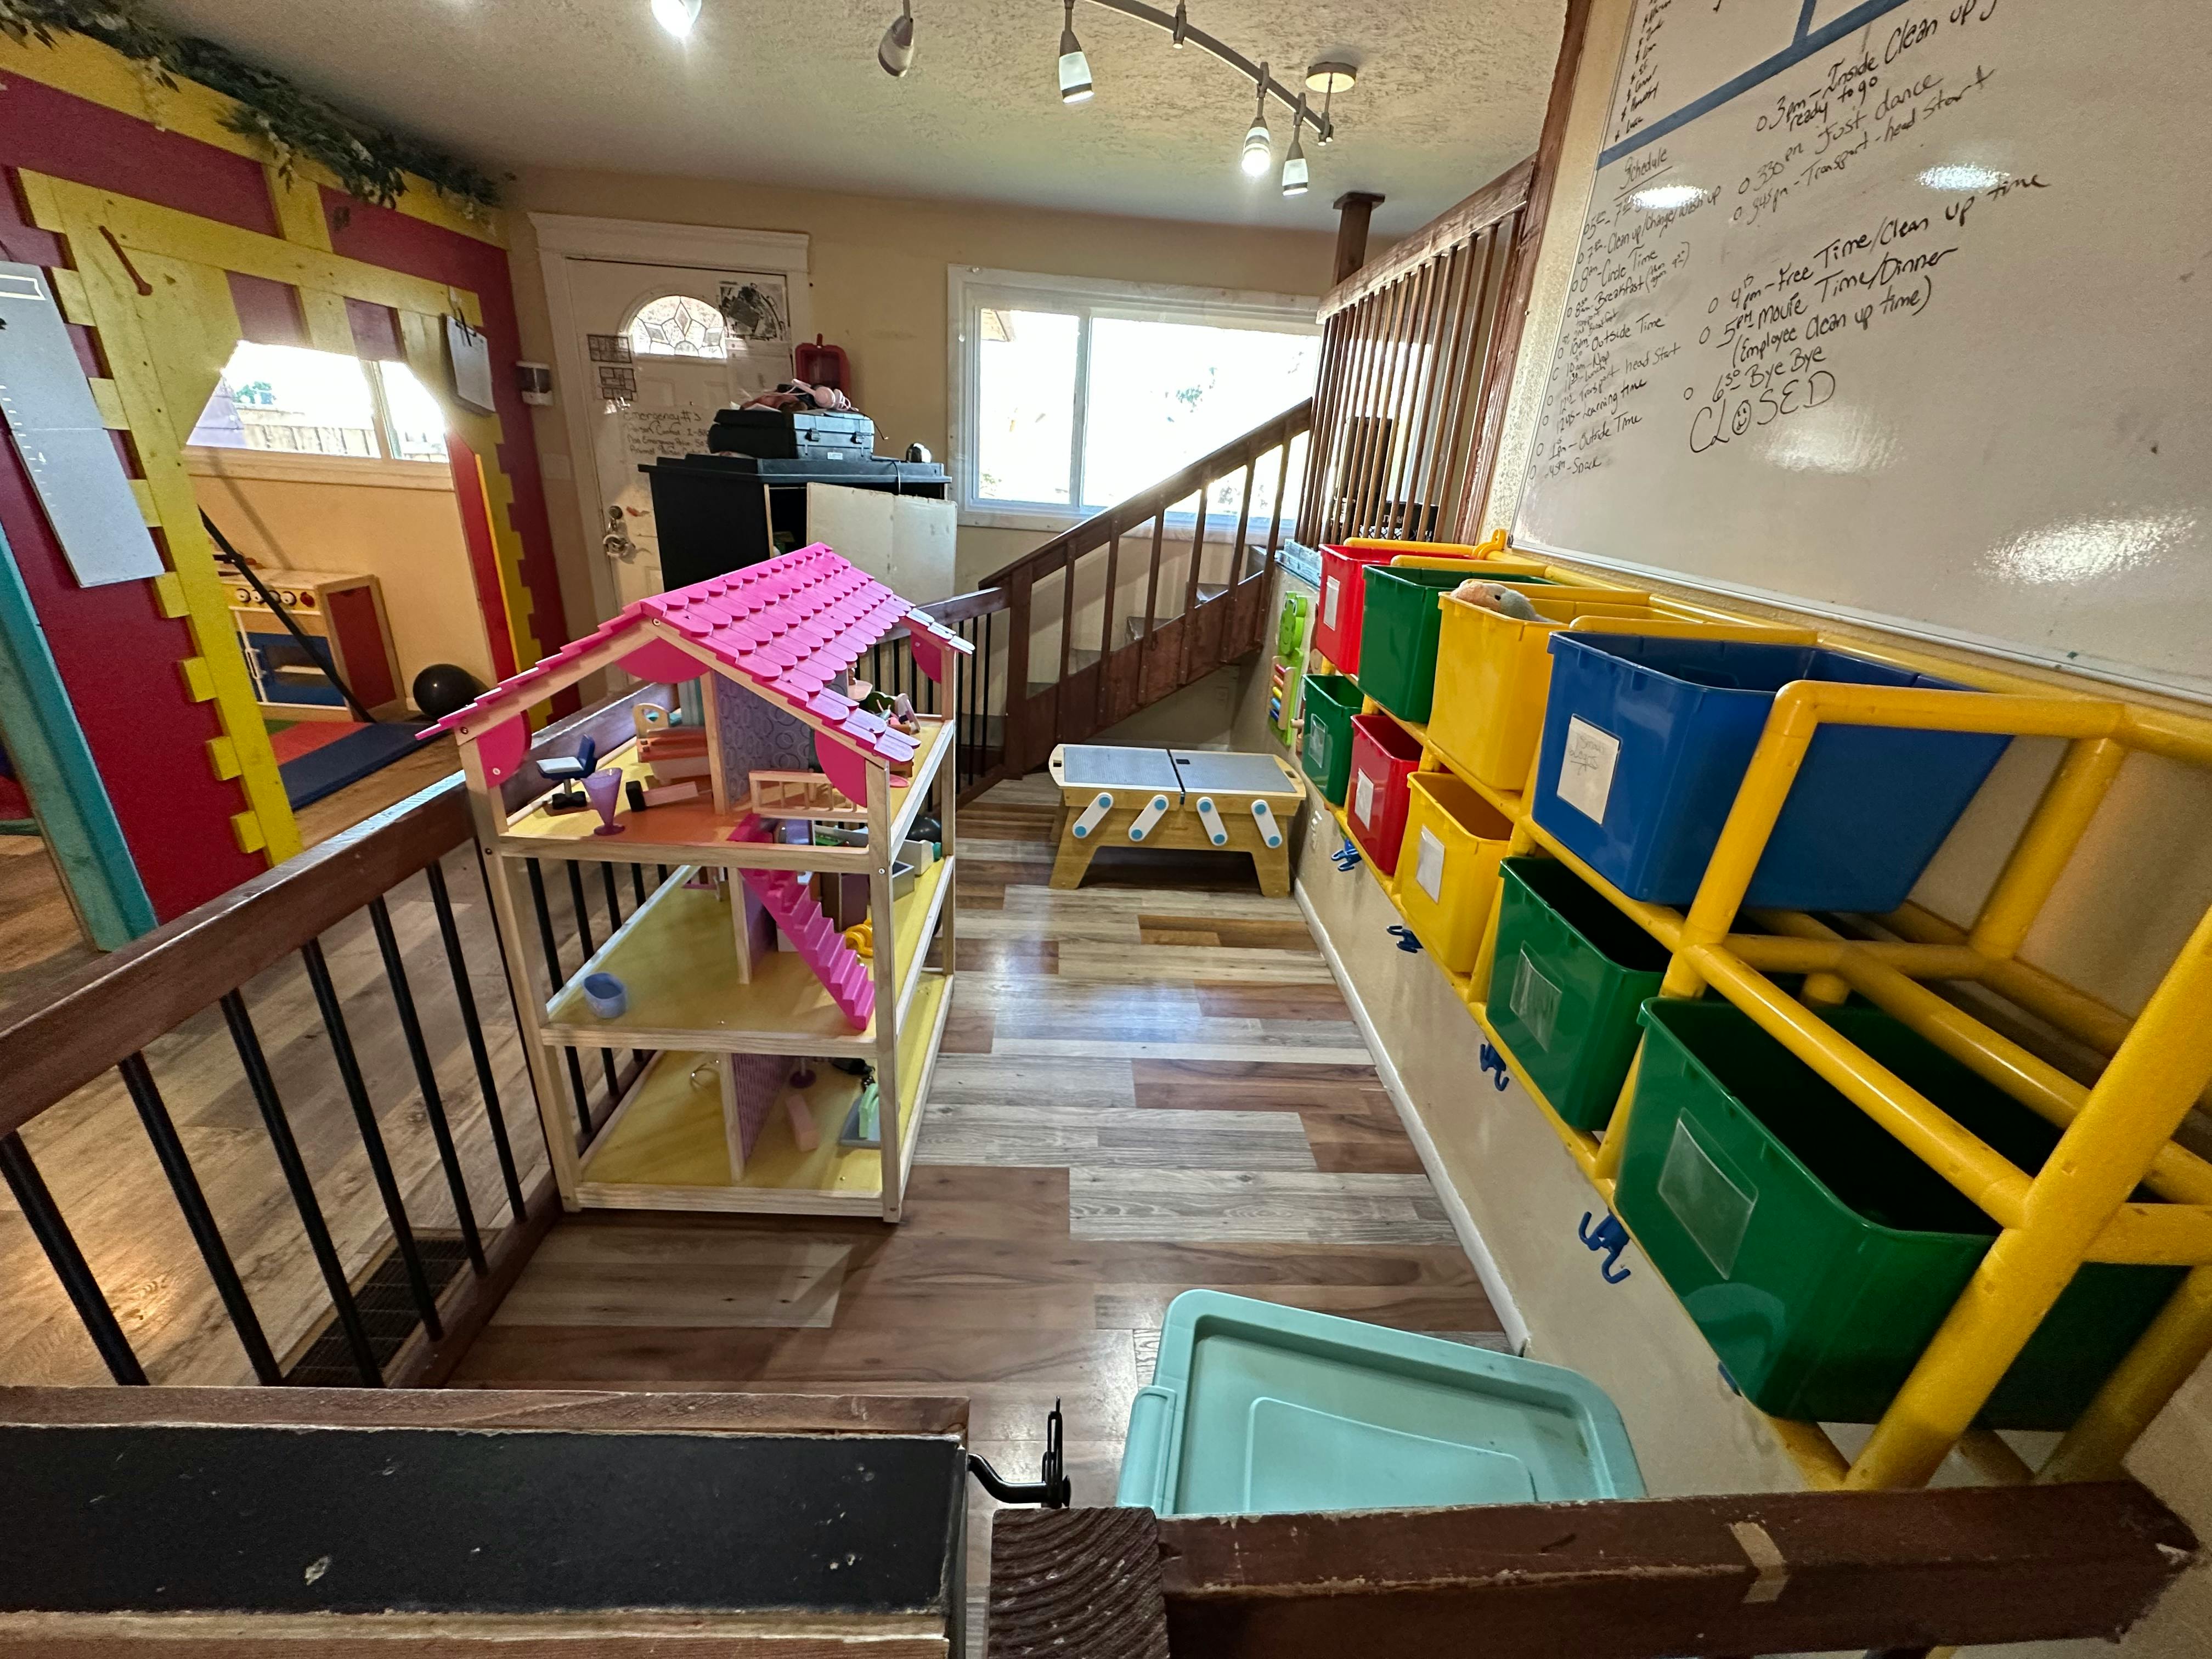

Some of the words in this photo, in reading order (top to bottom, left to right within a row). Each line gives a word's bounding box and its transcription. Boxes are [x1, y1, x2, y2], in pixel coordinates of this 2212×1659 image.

[1822, 52, 1879, 99] Inside
[1885, 19, 1938, 64] Clean
[1791, 101, 1828, 131] ready
[1838, 84, 1853, 103] to
[1858, 76, 1878, 103] go
[1875, 75, 1944, 120] dance
[1620, 148, 1667, 189] Schedule
[1607, 233, 1629, 254] Clean
[1707, 185, 1721, 206] up
[1945, 197, 1974, 227] up
[1987, 174, 2051, 201] time
[1628, 244, 1658, 271] Time
[1592, 324, 1632, 352] Outside
[1636, 313, 1666, 334] Time
[1807, 313, 1847, 340] Clean
[1855, 305, 1872, 330] up
[1745, 361, 1784, 388] Bye
[1790, 346, 1827, 373] Bye
